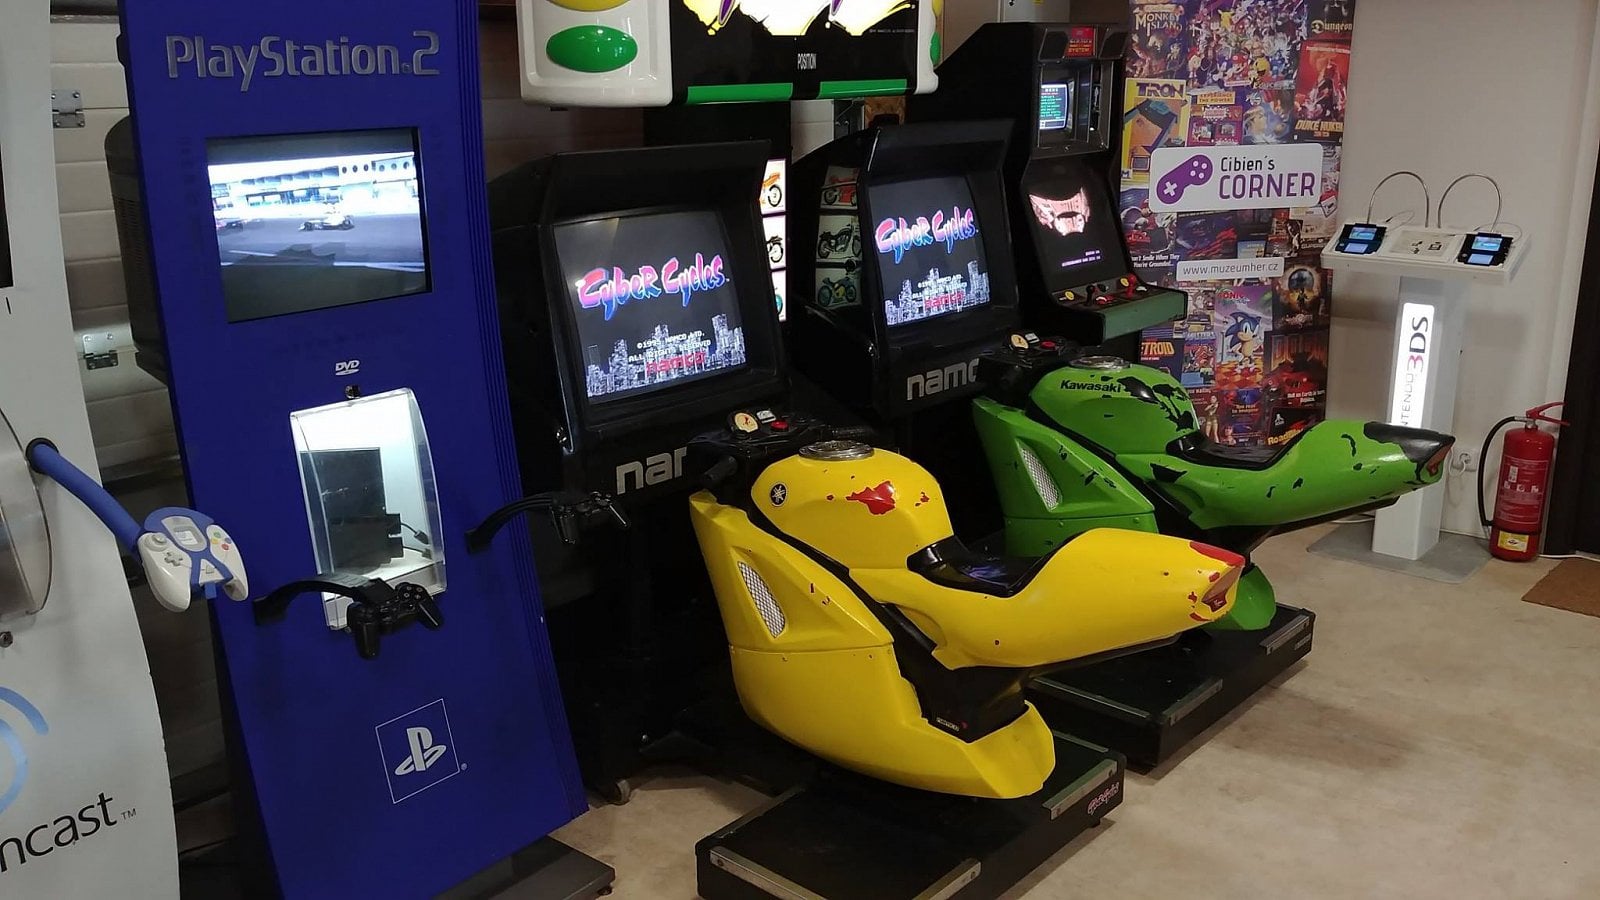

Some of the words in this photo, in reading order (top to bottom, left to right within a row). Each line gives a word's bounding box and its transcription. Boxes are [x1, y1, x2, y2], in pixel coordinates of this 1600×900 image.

[1135, 13, 1180, 31] MONKEY
[1311, 20, 1353, 34] Dungeon
[166, 36, 400, 92] PlayStation
[797, 53, 817, 70] POSITION
[1136, 82, 1184, 97] TRON
[1295, 119, 1320, 131] DUKE
[1218, 172, 1315, 200] CORNER
[1182, 262, 1279, 276] www.muzeumher.cz
[661, 252, 727, 308] Cycles
[1140, 340, 1175, 356] TROID
[1406, 316, 1428, 372] 3DS
[335, 360, 360, 371] DVD
[907, 357, 980, 401] namc
[1061, 379, 1121, 393] Kawasaki
